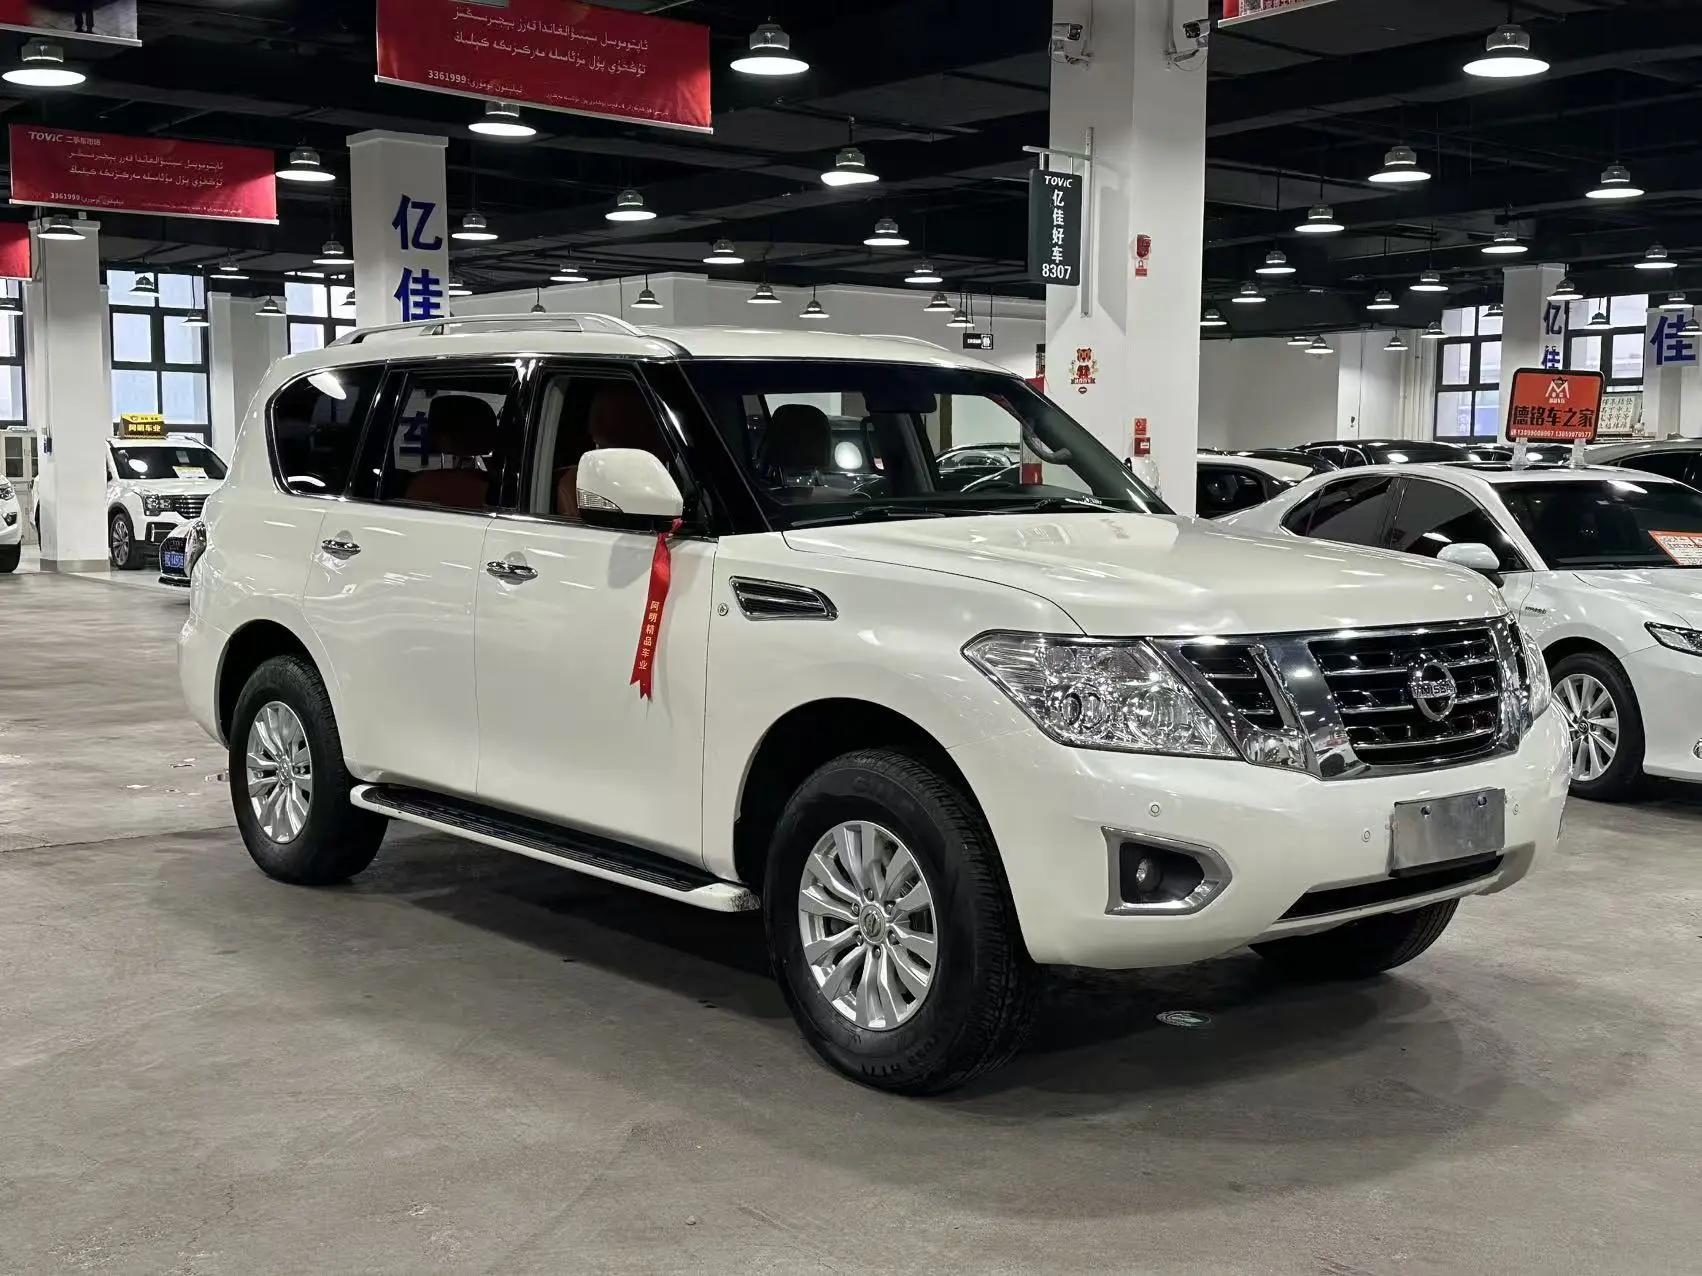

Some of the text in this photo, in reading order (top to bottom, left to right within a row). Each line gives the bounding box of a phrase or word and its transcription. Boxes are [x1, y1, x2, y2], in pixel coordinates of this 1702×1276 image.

[1044, 175, 1073, 188] TOVIC
[1052, 189, 1065, 264] 亿佳好车
[1042, 263, 1072, 280] 8307
[1650, 314, 1697, 366] 佳
